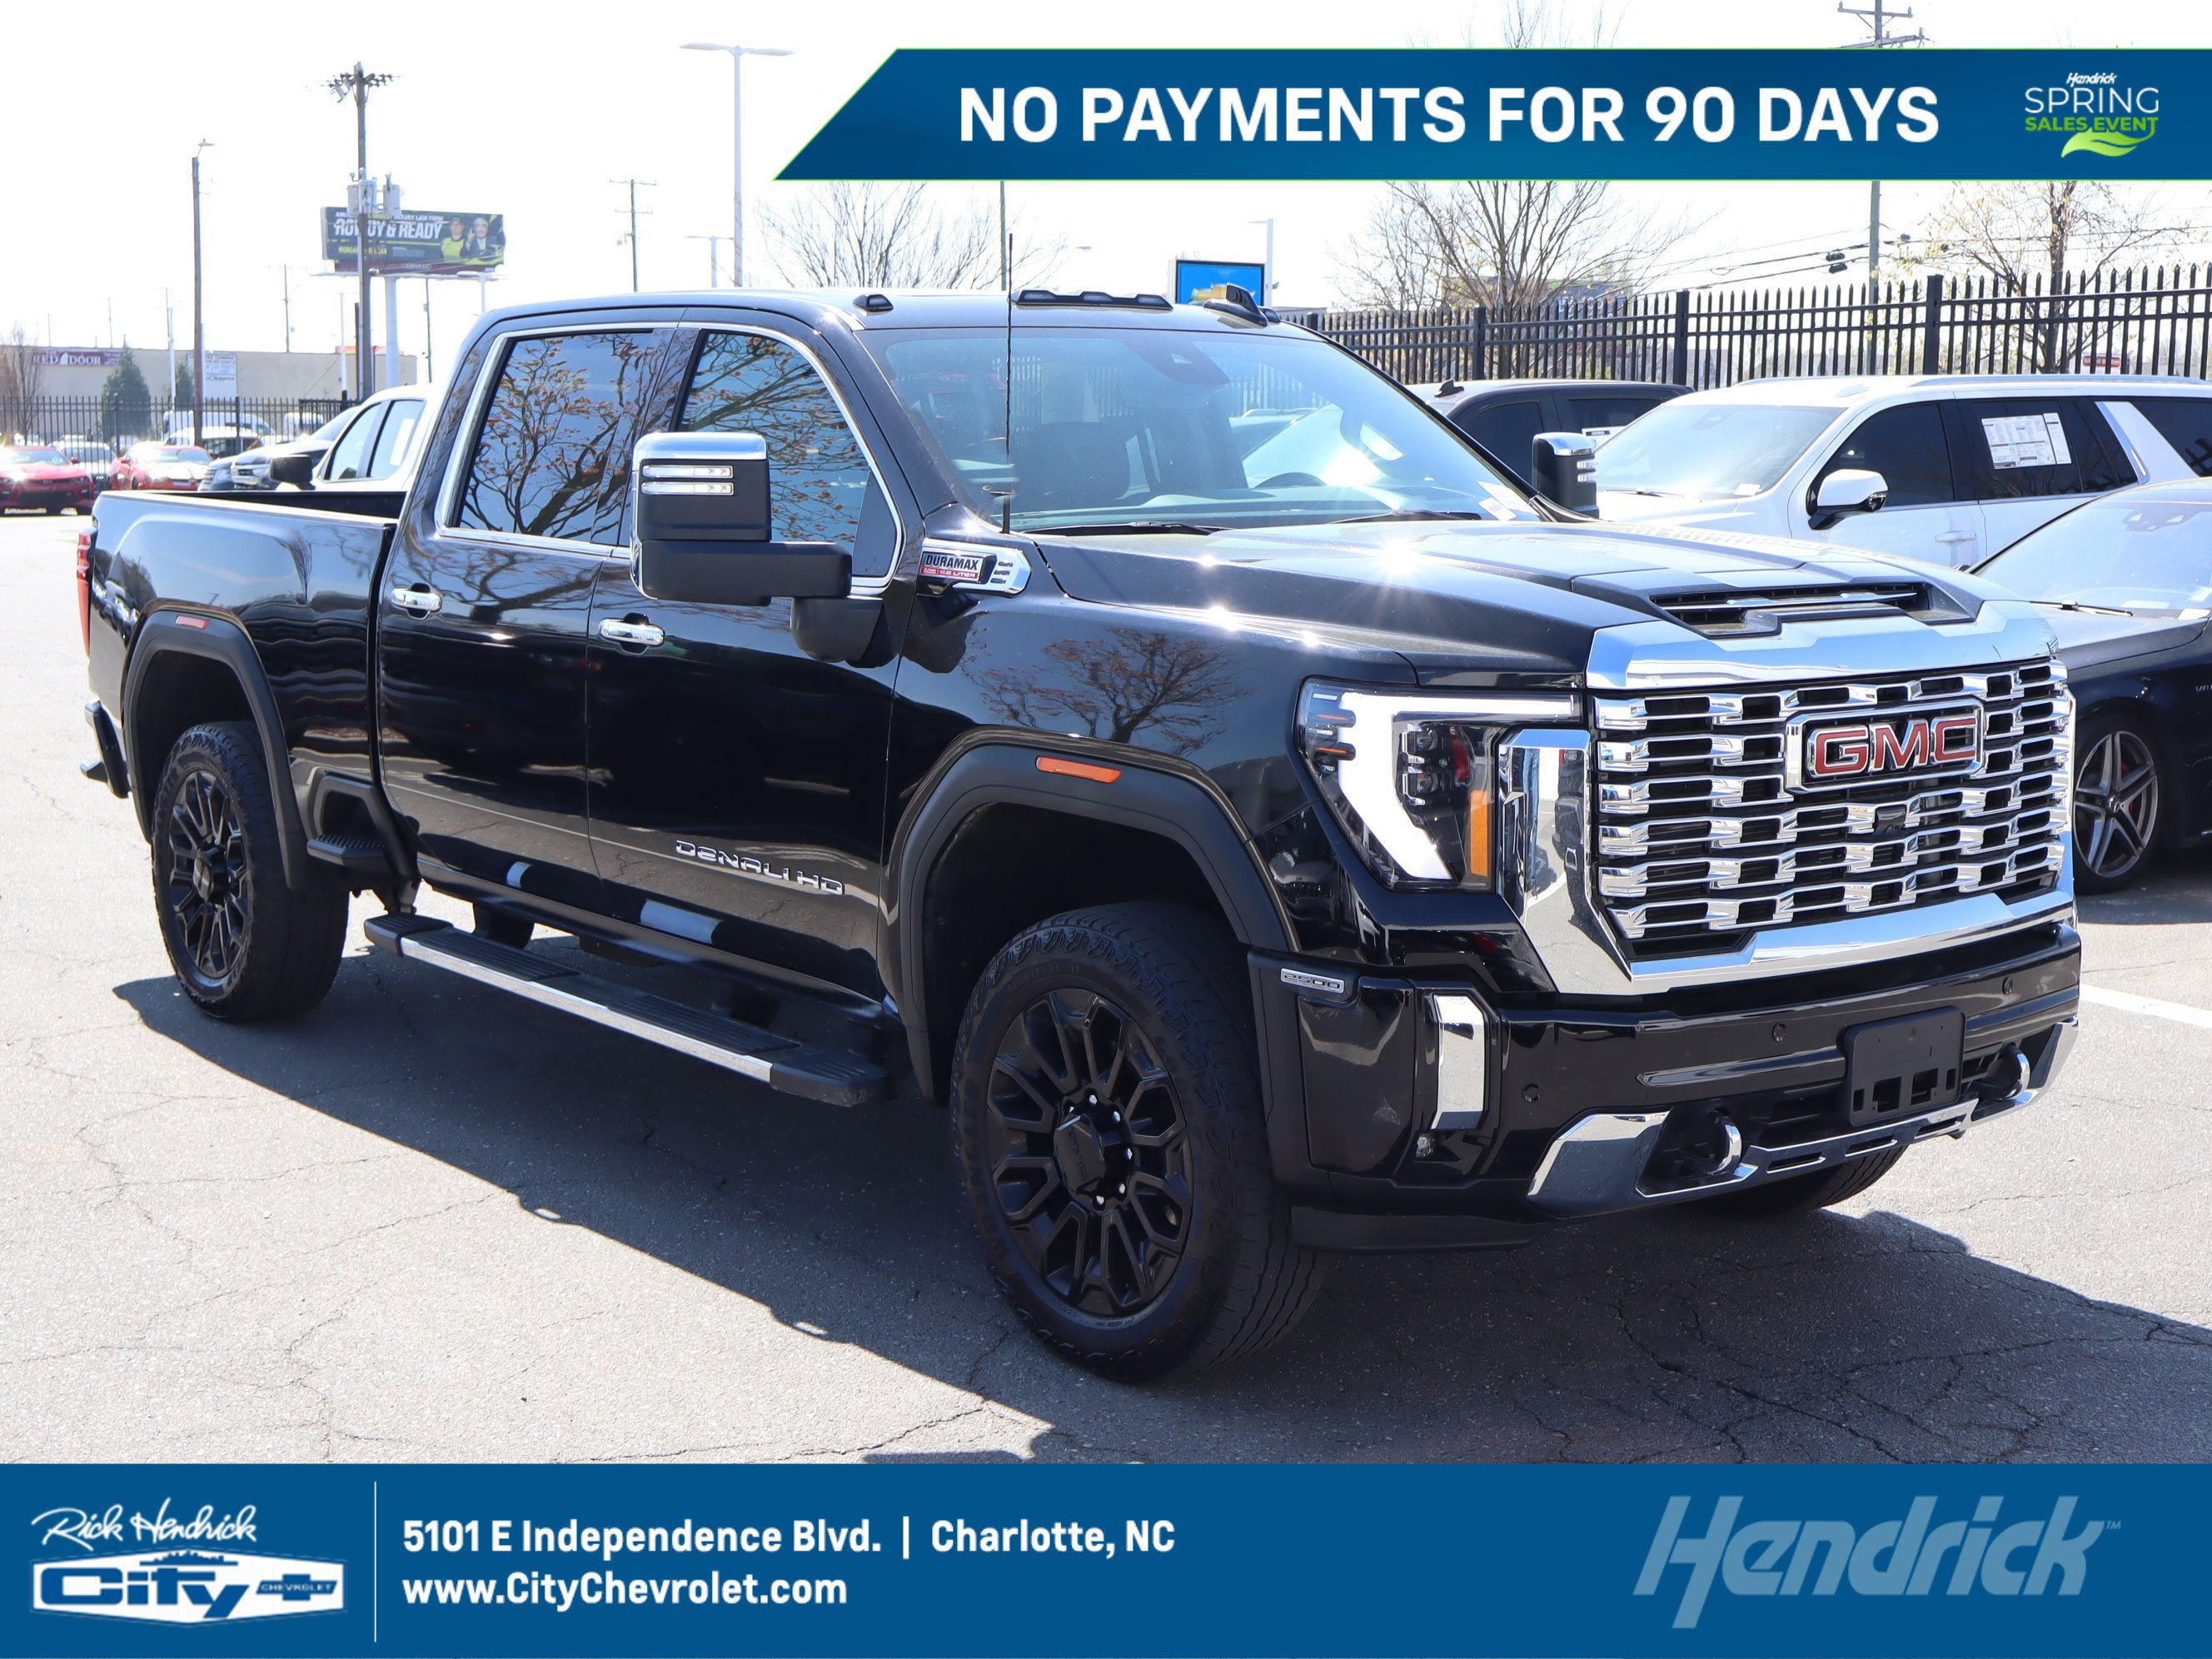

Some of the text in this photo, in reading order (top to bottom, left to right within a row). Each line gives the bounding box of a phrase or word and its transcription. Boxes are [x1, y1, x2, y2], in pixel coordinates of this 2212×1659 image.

[69, 356, 101, 365] DOOR
[925, 554, 979, 570] DURAMAX
[1806, 719, 1976, 778] GMC
[675, 839, 844, 896] DENALI HD
[1283, 973, 1340, 989] 2500
